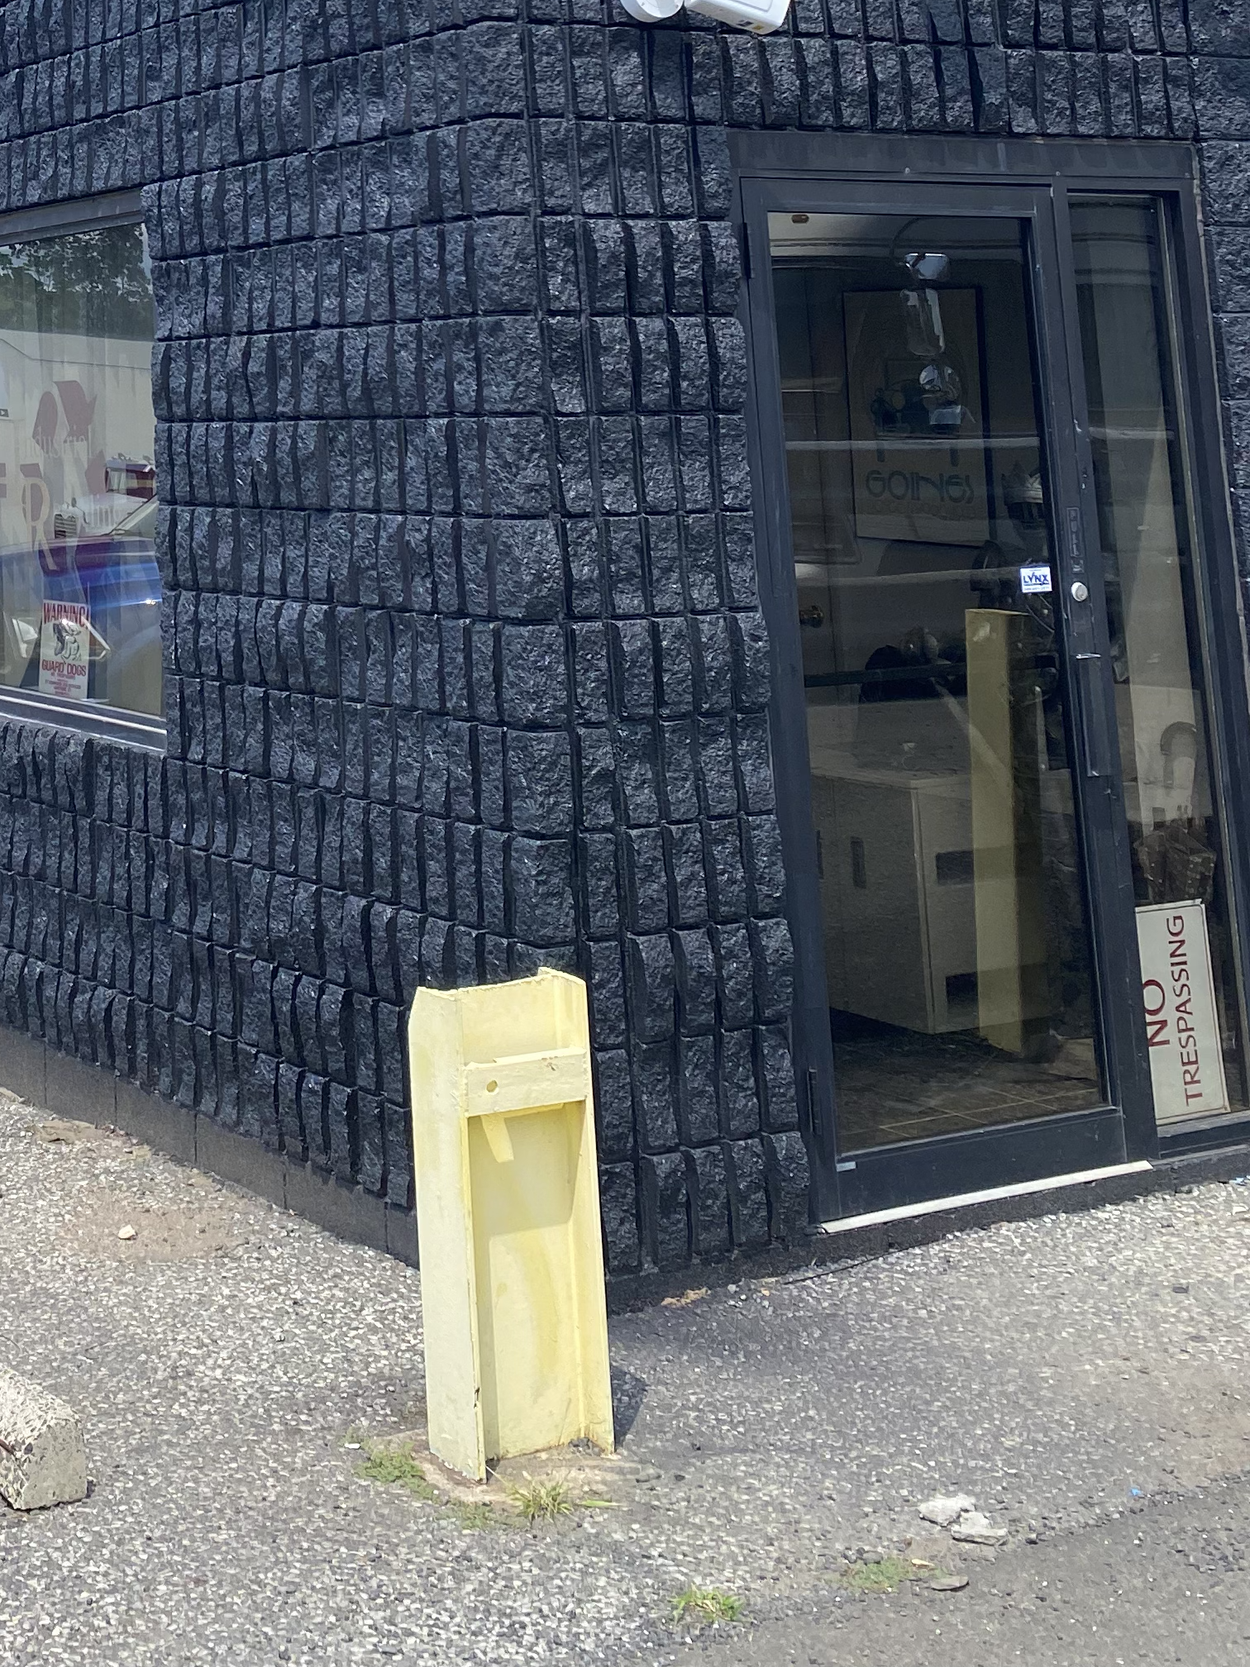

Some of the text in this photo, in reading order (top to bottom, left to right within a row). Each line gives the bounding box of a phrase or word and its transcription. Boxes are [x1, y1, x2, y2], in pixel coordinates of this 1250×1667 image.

[1023, 572, 1050, 586] LYNX
[42, 659, 64, 673] GUARD
[67, 663, 86, 677] DOGS
[1144, 979, 1170, 1048] NO
[1166, 914, 1203, 1107] TRESPASSING
